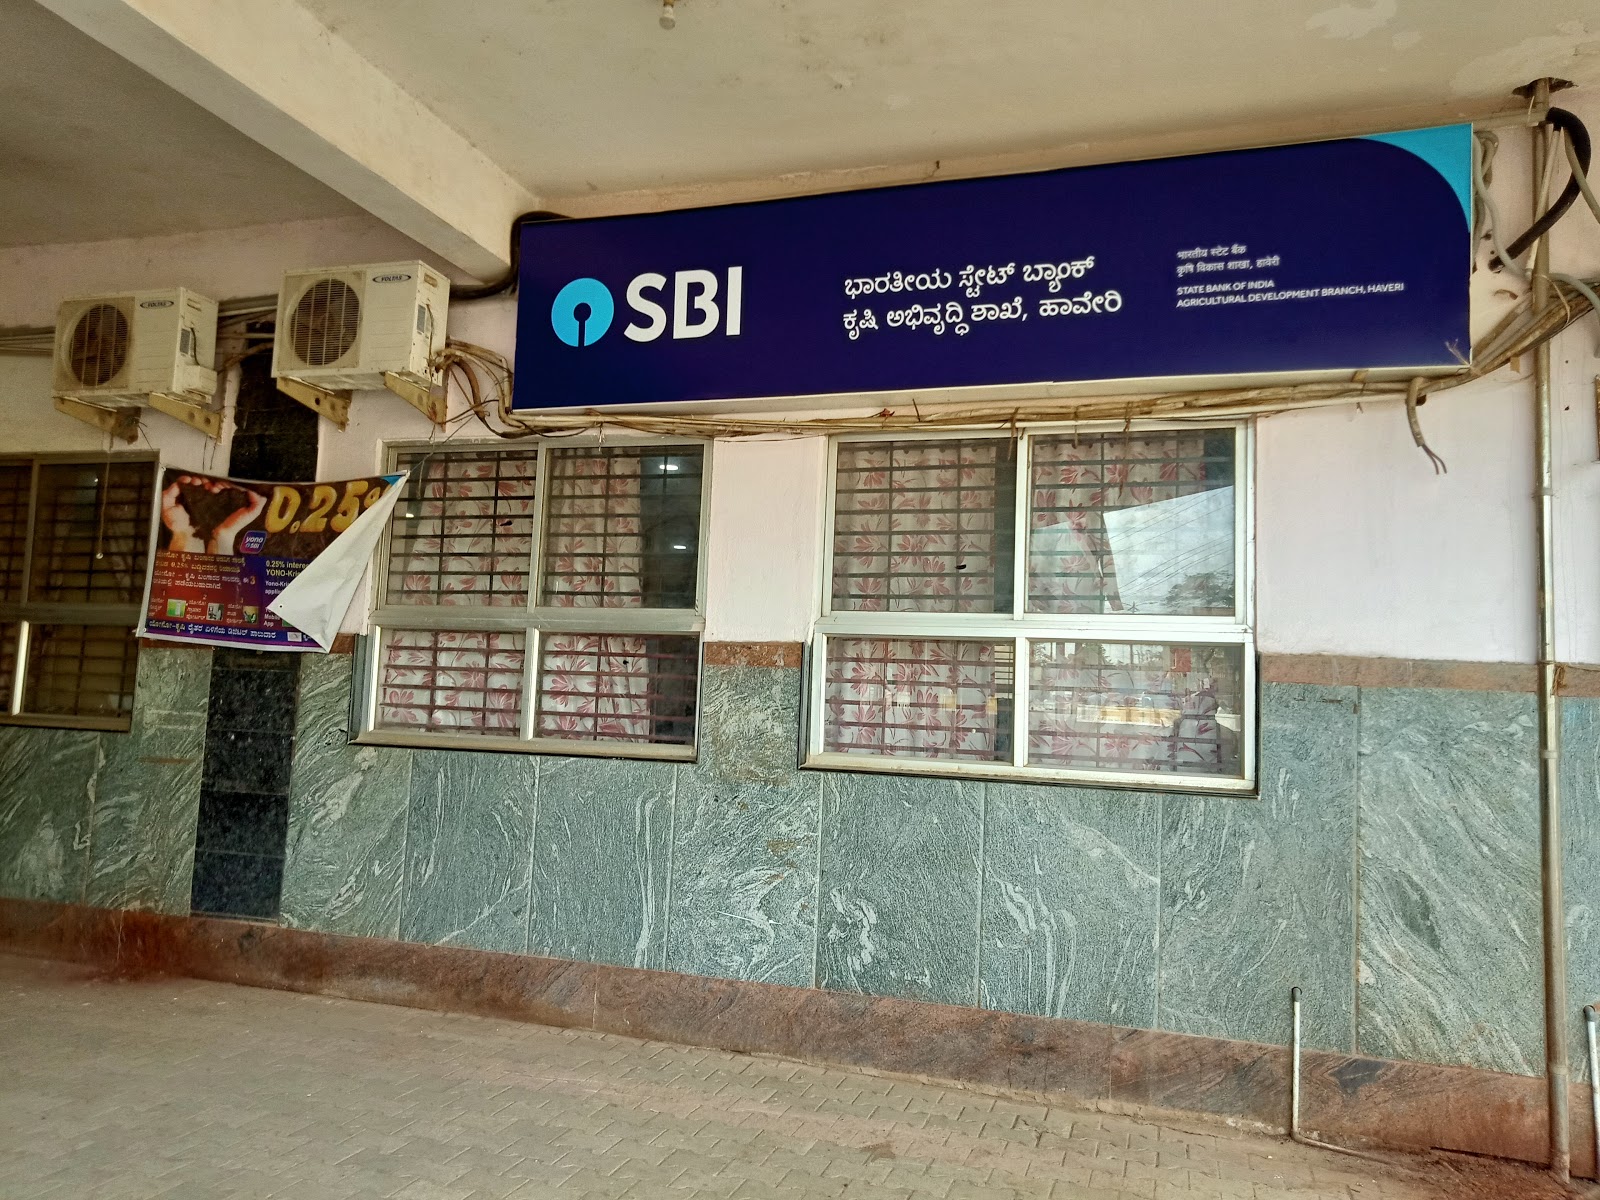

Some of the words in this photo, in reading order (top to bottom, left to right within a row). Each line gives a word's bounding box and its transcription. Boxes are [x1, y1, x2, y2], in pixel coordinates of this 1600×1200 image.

[1176, 247, 1208, 260] भारतीय
[1210, 245, 1229, 257] स्टेट
[1176, 262, 1194, 278] कृषि
[1196, 261, 1225, 272] विकास
[1256, 255, 1280, 268] हावेरी
[844, 268, 952, 299] ಭಾರತೀಯ
[958, 262, 1017, 298] ಸ್ಟೇಟ್
[1022, 256, 1095, 293] ಬ್ಯಾಂಕ್
[1176, 285, 1205, 296] STATE
[1205, 283, 1232, 294] BANK
[1232, 281, 1246, 291] OF
[1247, 280, 1275, 290] INDIA
[1176, 294, 1247, 308] AGRICULTURAL
[1247, 288, 1321, 303] DEVELOPMENT
[1321, 285, 1367, 297] BRANCH,
[1367, 282, 1405, 294] HAVERI
[624, 266, 742, 342] SBI
[842, 308, 879, 340] ಕೃಷಿ
[886, 301, 970, 336] ಅಭಿವೃದ್ಧಿ
[971, 296, 1029, 322] ಶಾಖೆ,
[1039, 289, 1123, 317] ಹಾವೇರಿ
[245, 536, 264, 544] yono
[266, 560, 285, 568] 0.25%
[250, 576, 256, 585] 3
[263, 620, 274, 628] App
